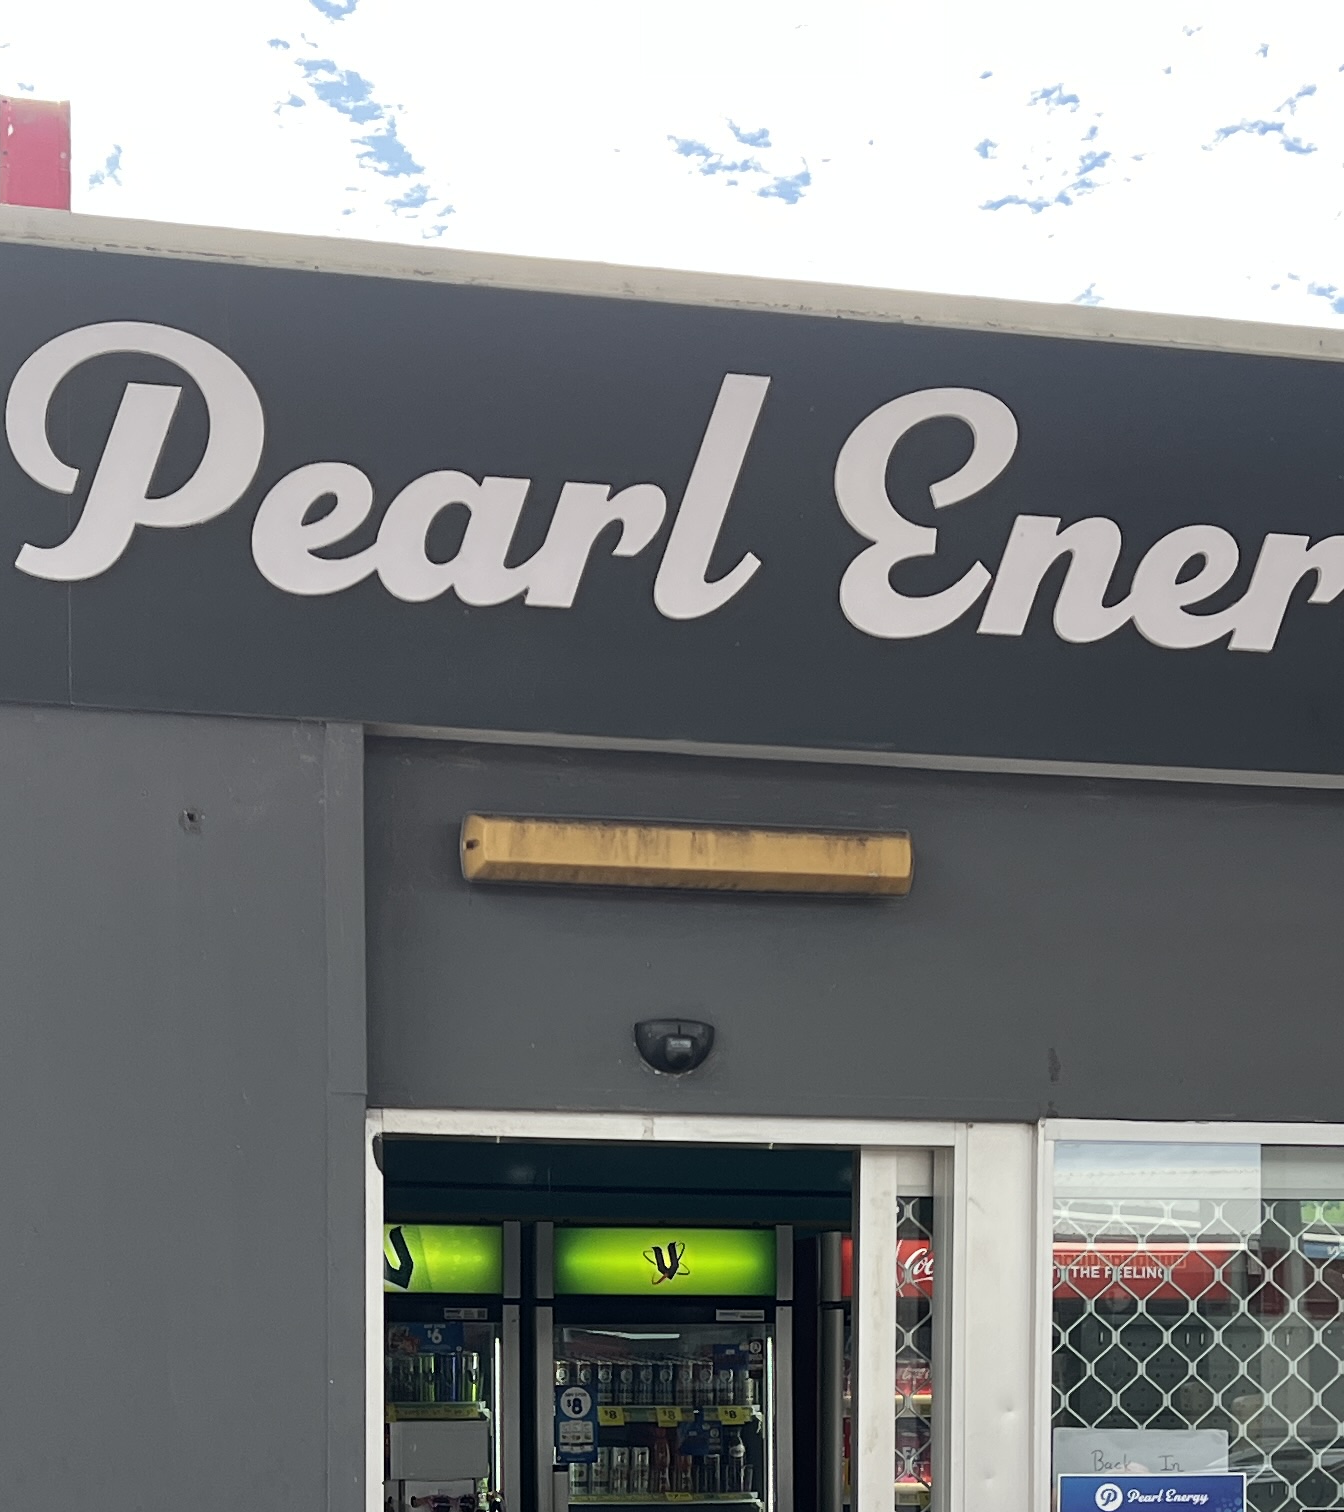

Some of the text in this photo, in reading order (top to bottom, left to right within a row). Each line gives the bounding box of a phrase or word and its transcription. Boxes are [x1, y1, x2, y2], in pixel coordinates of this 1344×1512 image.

[5, 321, 772, 621] Pearl
[1071, 1265, 1101, 1279] THE
[1090, 1449, 1185, 1473] Back In
[1126, 1488, 1209, 1506] Pearl Energy
